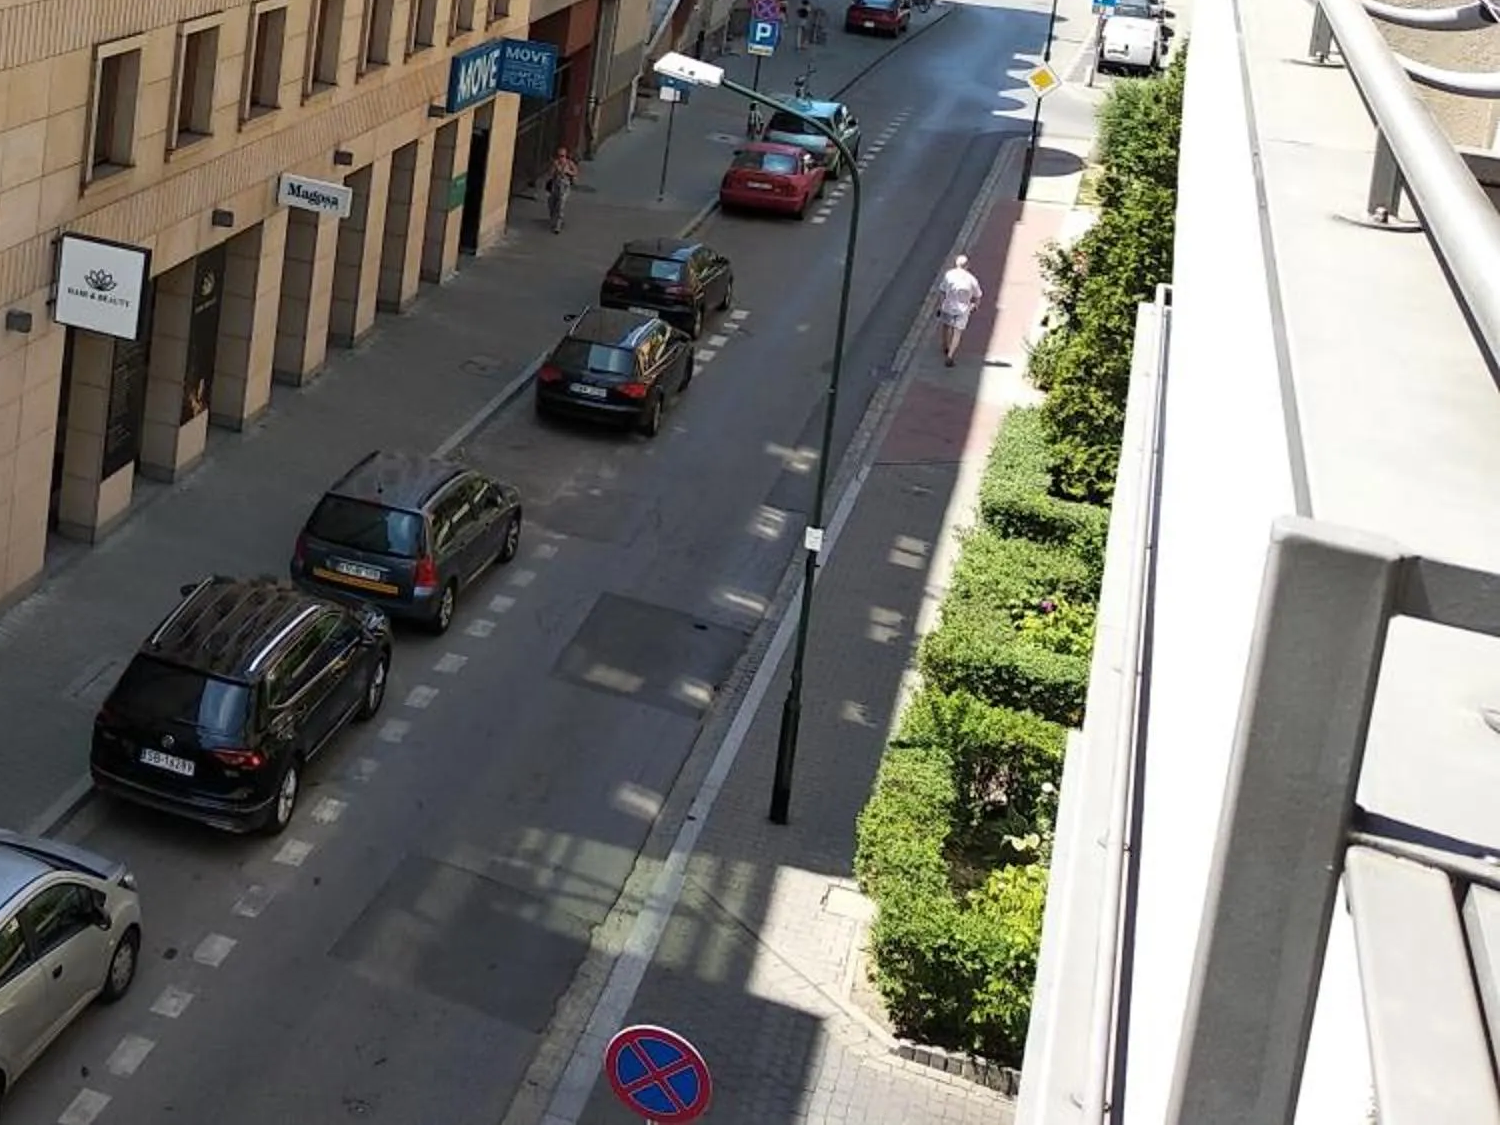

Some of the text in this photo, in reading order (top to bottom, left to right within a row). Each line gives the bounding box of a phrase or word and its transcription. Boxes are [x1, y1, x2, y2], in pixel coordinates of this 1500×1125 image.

[755, 22, 772, 41] P
[505, 46, 552, 64] MOVE
[457, 47, 500, 103] MOVE
[98, 292, 131, 308] BEAUTY
